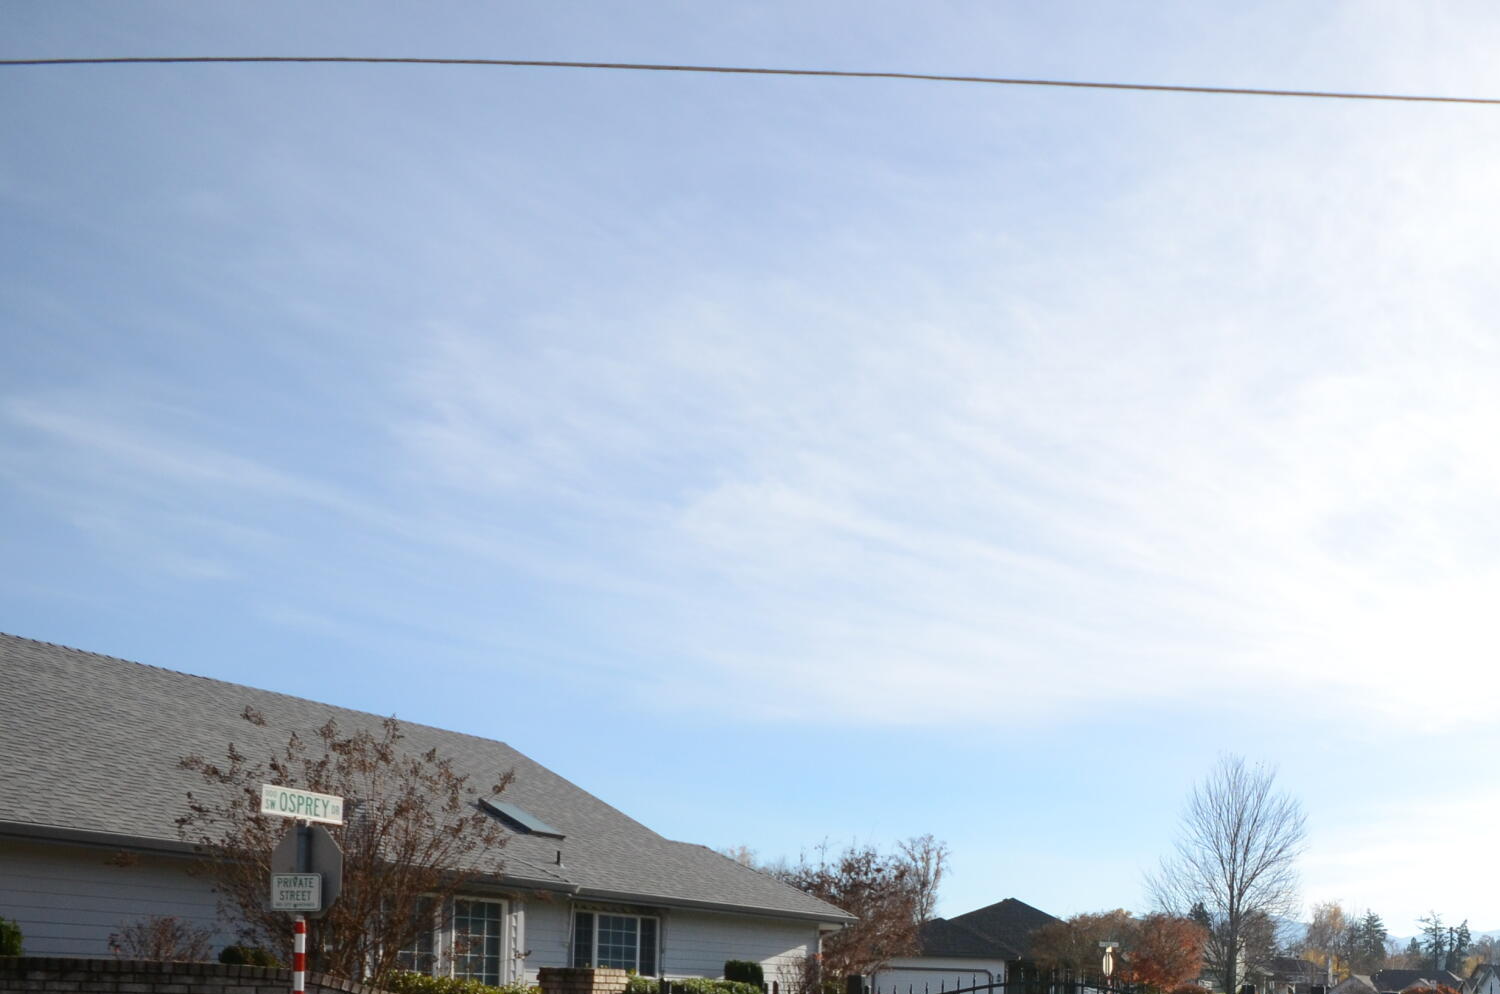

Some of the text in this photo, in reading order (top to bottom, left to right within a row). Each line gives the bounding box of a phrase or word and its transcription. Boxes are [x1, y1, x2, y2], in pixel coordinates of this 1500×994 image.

[265, 798, 277, 810] SW
[280, 791, 329, 818] OSPREY
[276, 877, 314, 889] PRIVATE
[279, 890, 312, 901] STREET
